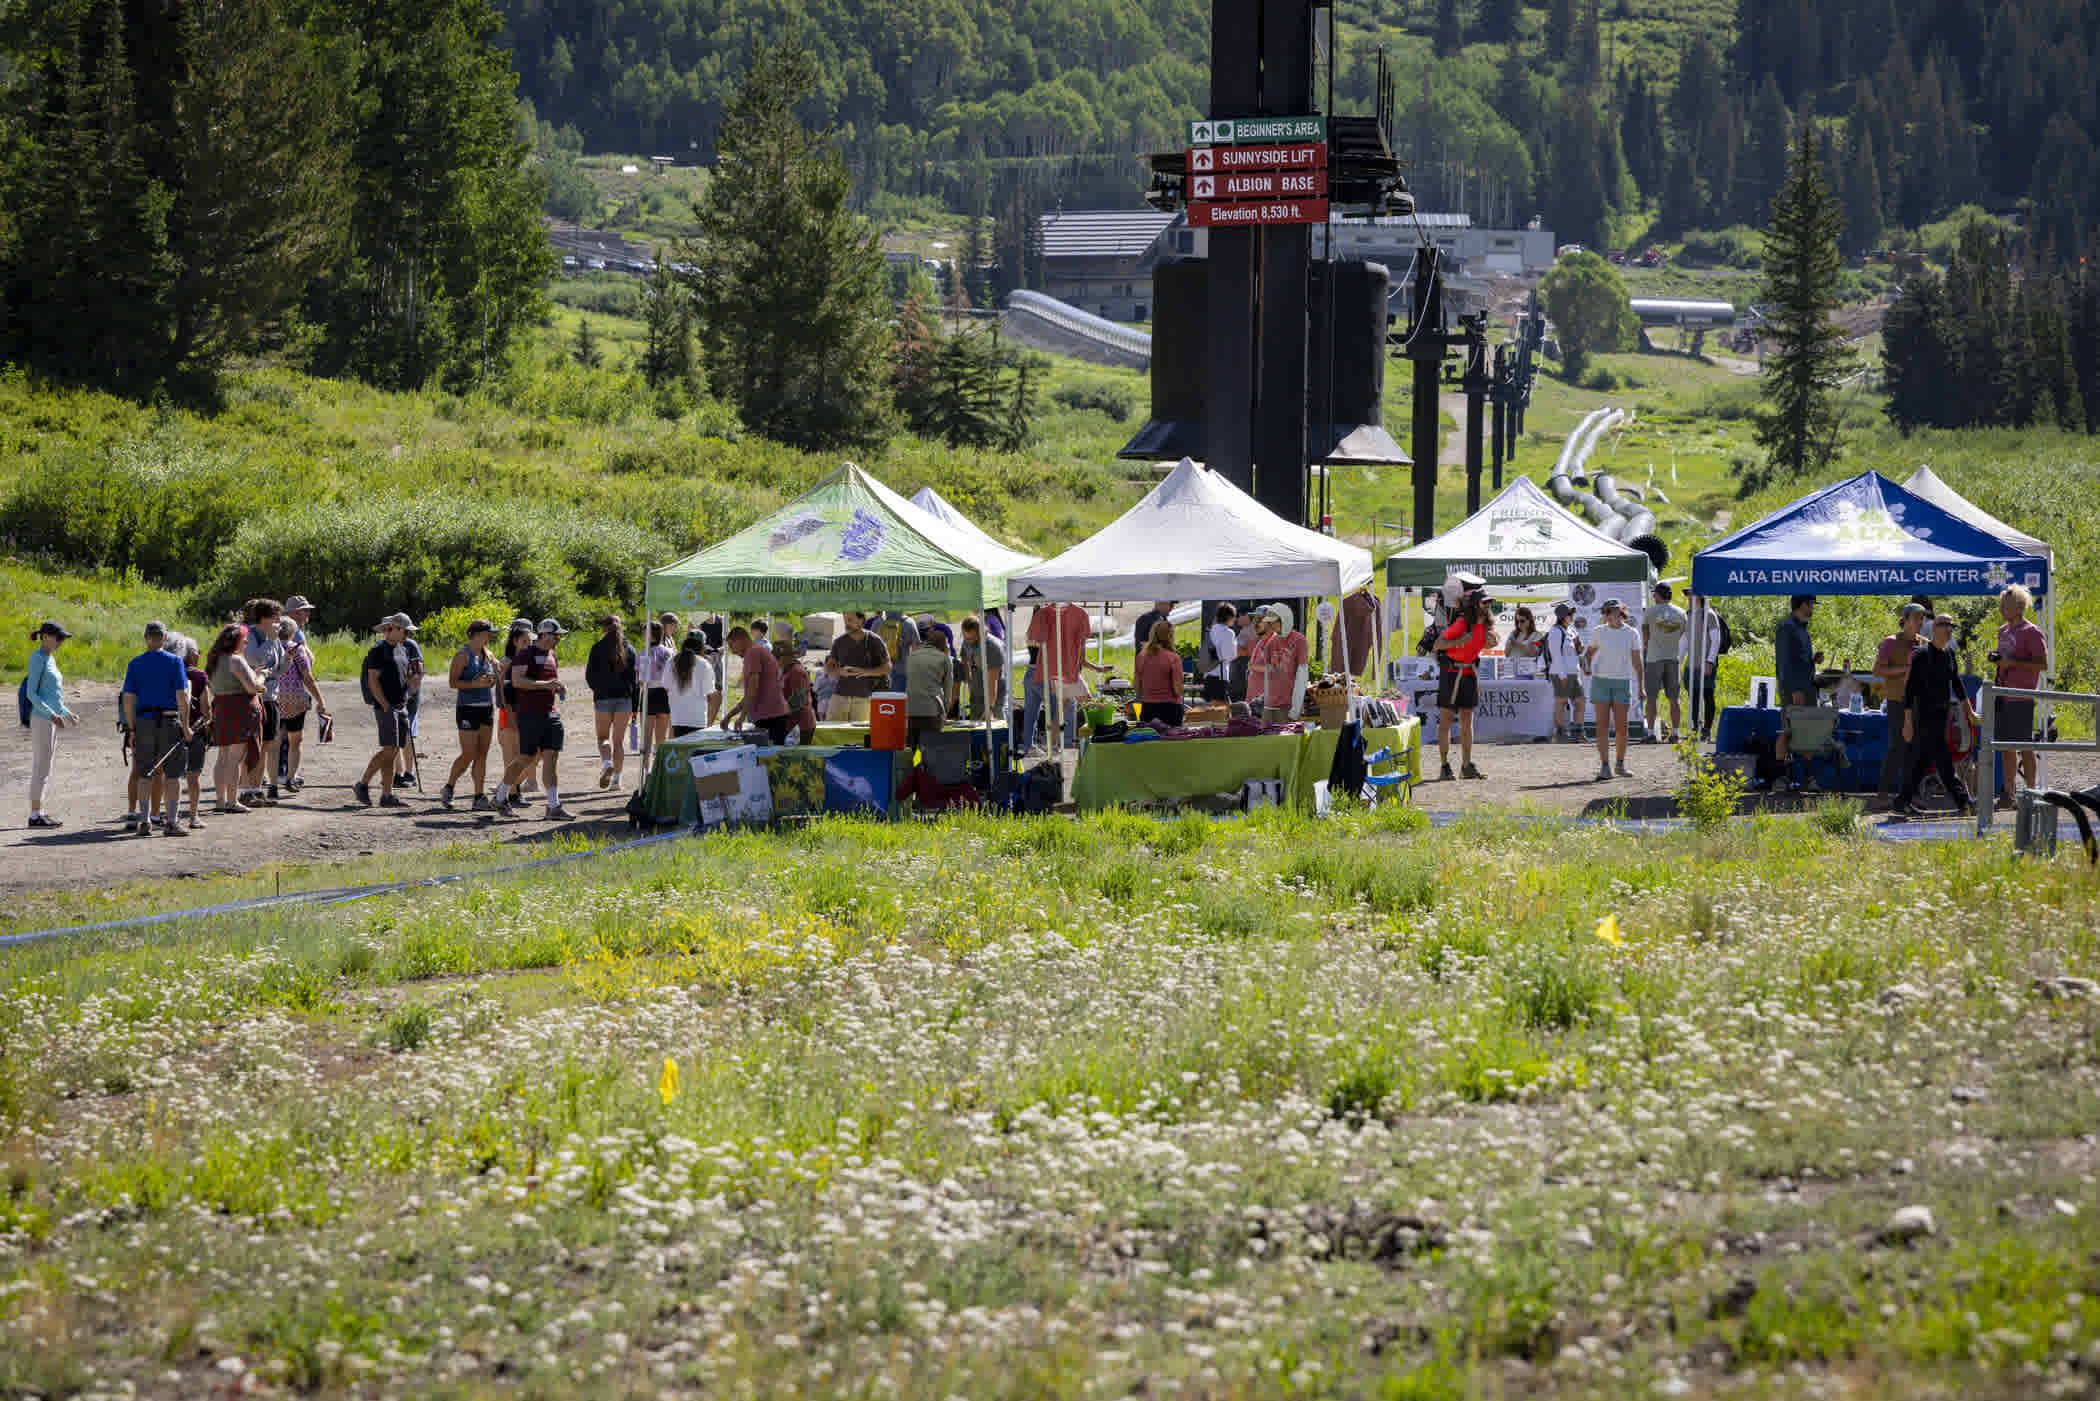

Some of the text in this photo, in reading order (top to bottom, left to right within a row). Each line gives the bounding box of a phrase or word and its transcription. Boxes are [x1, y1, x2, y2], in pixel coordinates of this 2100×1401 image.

[1236, 122, 1321, 137] BEGINNER'S AREA
[1222, 149, 1316, 165] SUNNYSIDE LIFT
[1227, 176, 1315, 192] ALBION BASE
[1211, 204, 1302, 221] Elevation 8,530 ft.
[1727, 568, 1980, 585] ALTA ENVIRONMENTAL CENTER
